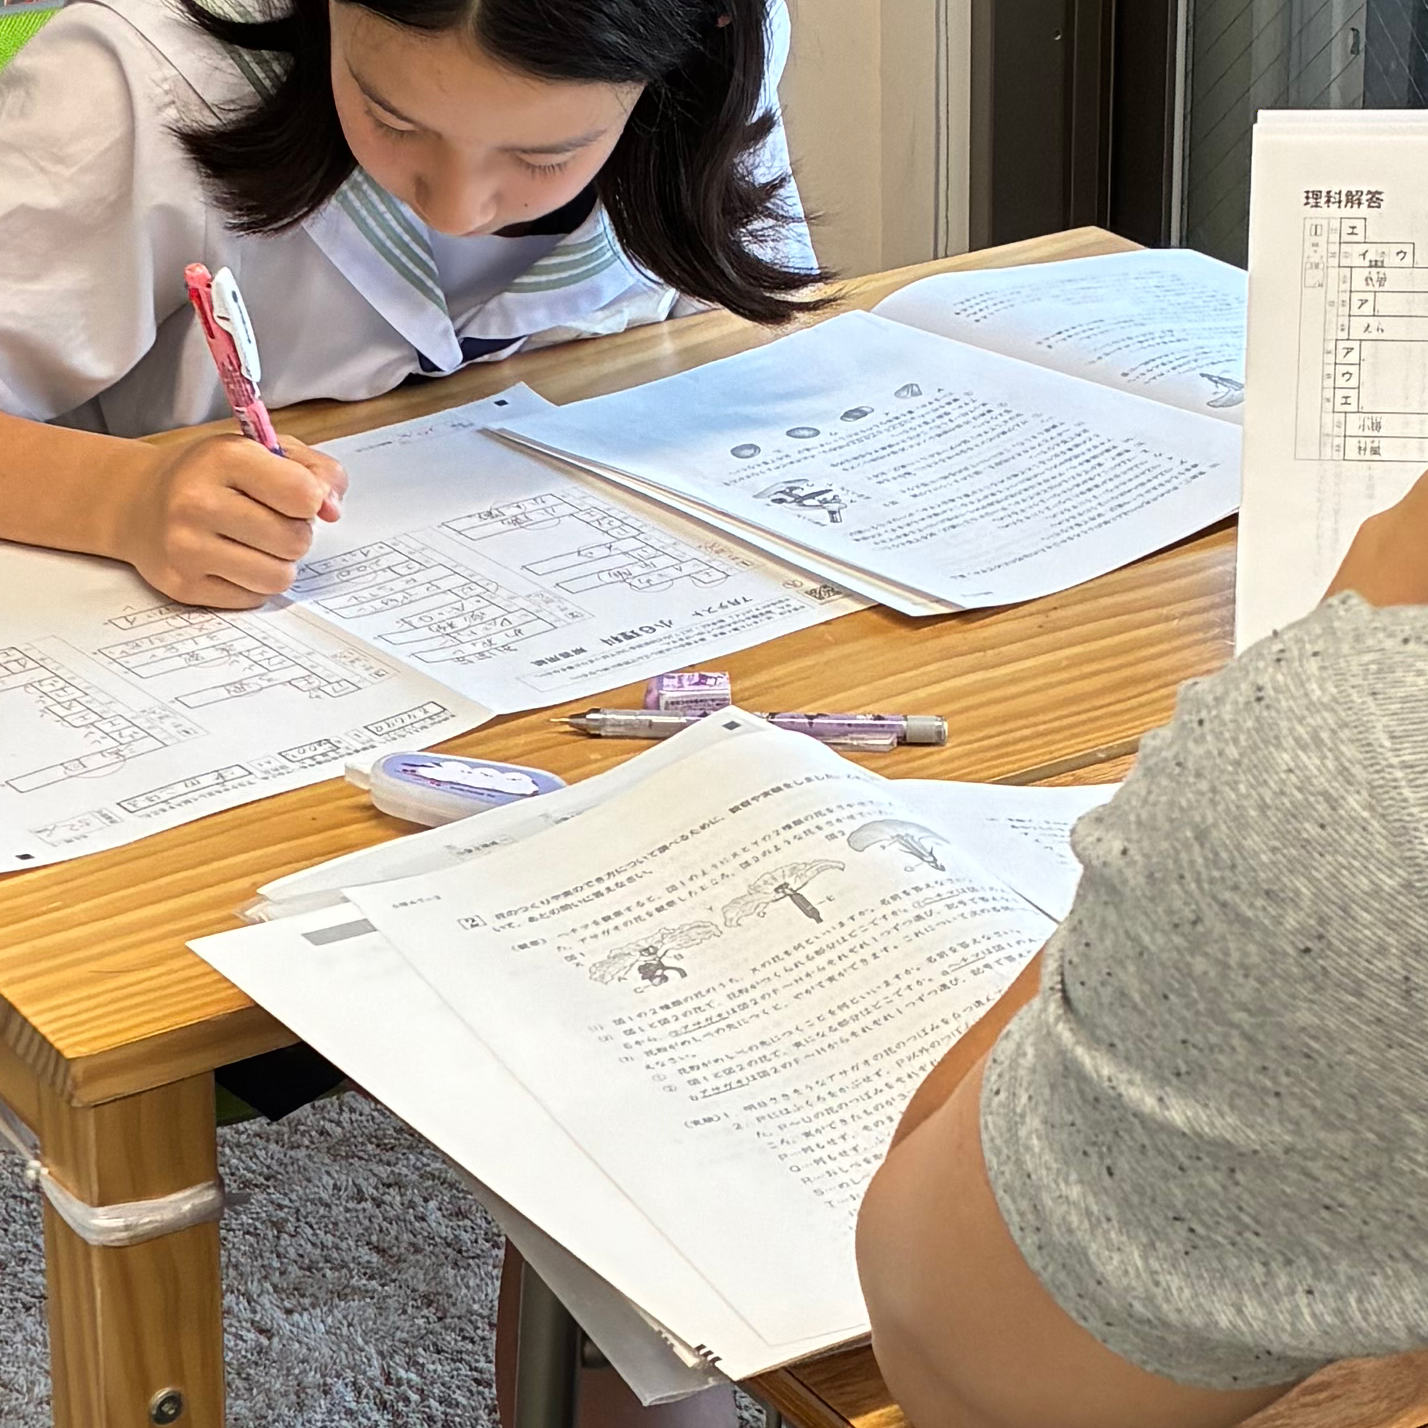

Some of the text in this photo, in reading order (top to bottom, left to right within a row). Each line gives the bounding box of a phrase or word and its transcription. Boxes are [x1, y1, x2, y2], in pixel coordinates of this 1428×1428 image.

[1303, 190, 1384, 209] 理科解答
[1357, 299, 1369, 310] ア
[1342, 348, 1354, 358] ア
[1342, 371, 1353, 382] ウ
[1340, 396, 1351, 405] エ
[598, 615, 674, 648] 小6理科
